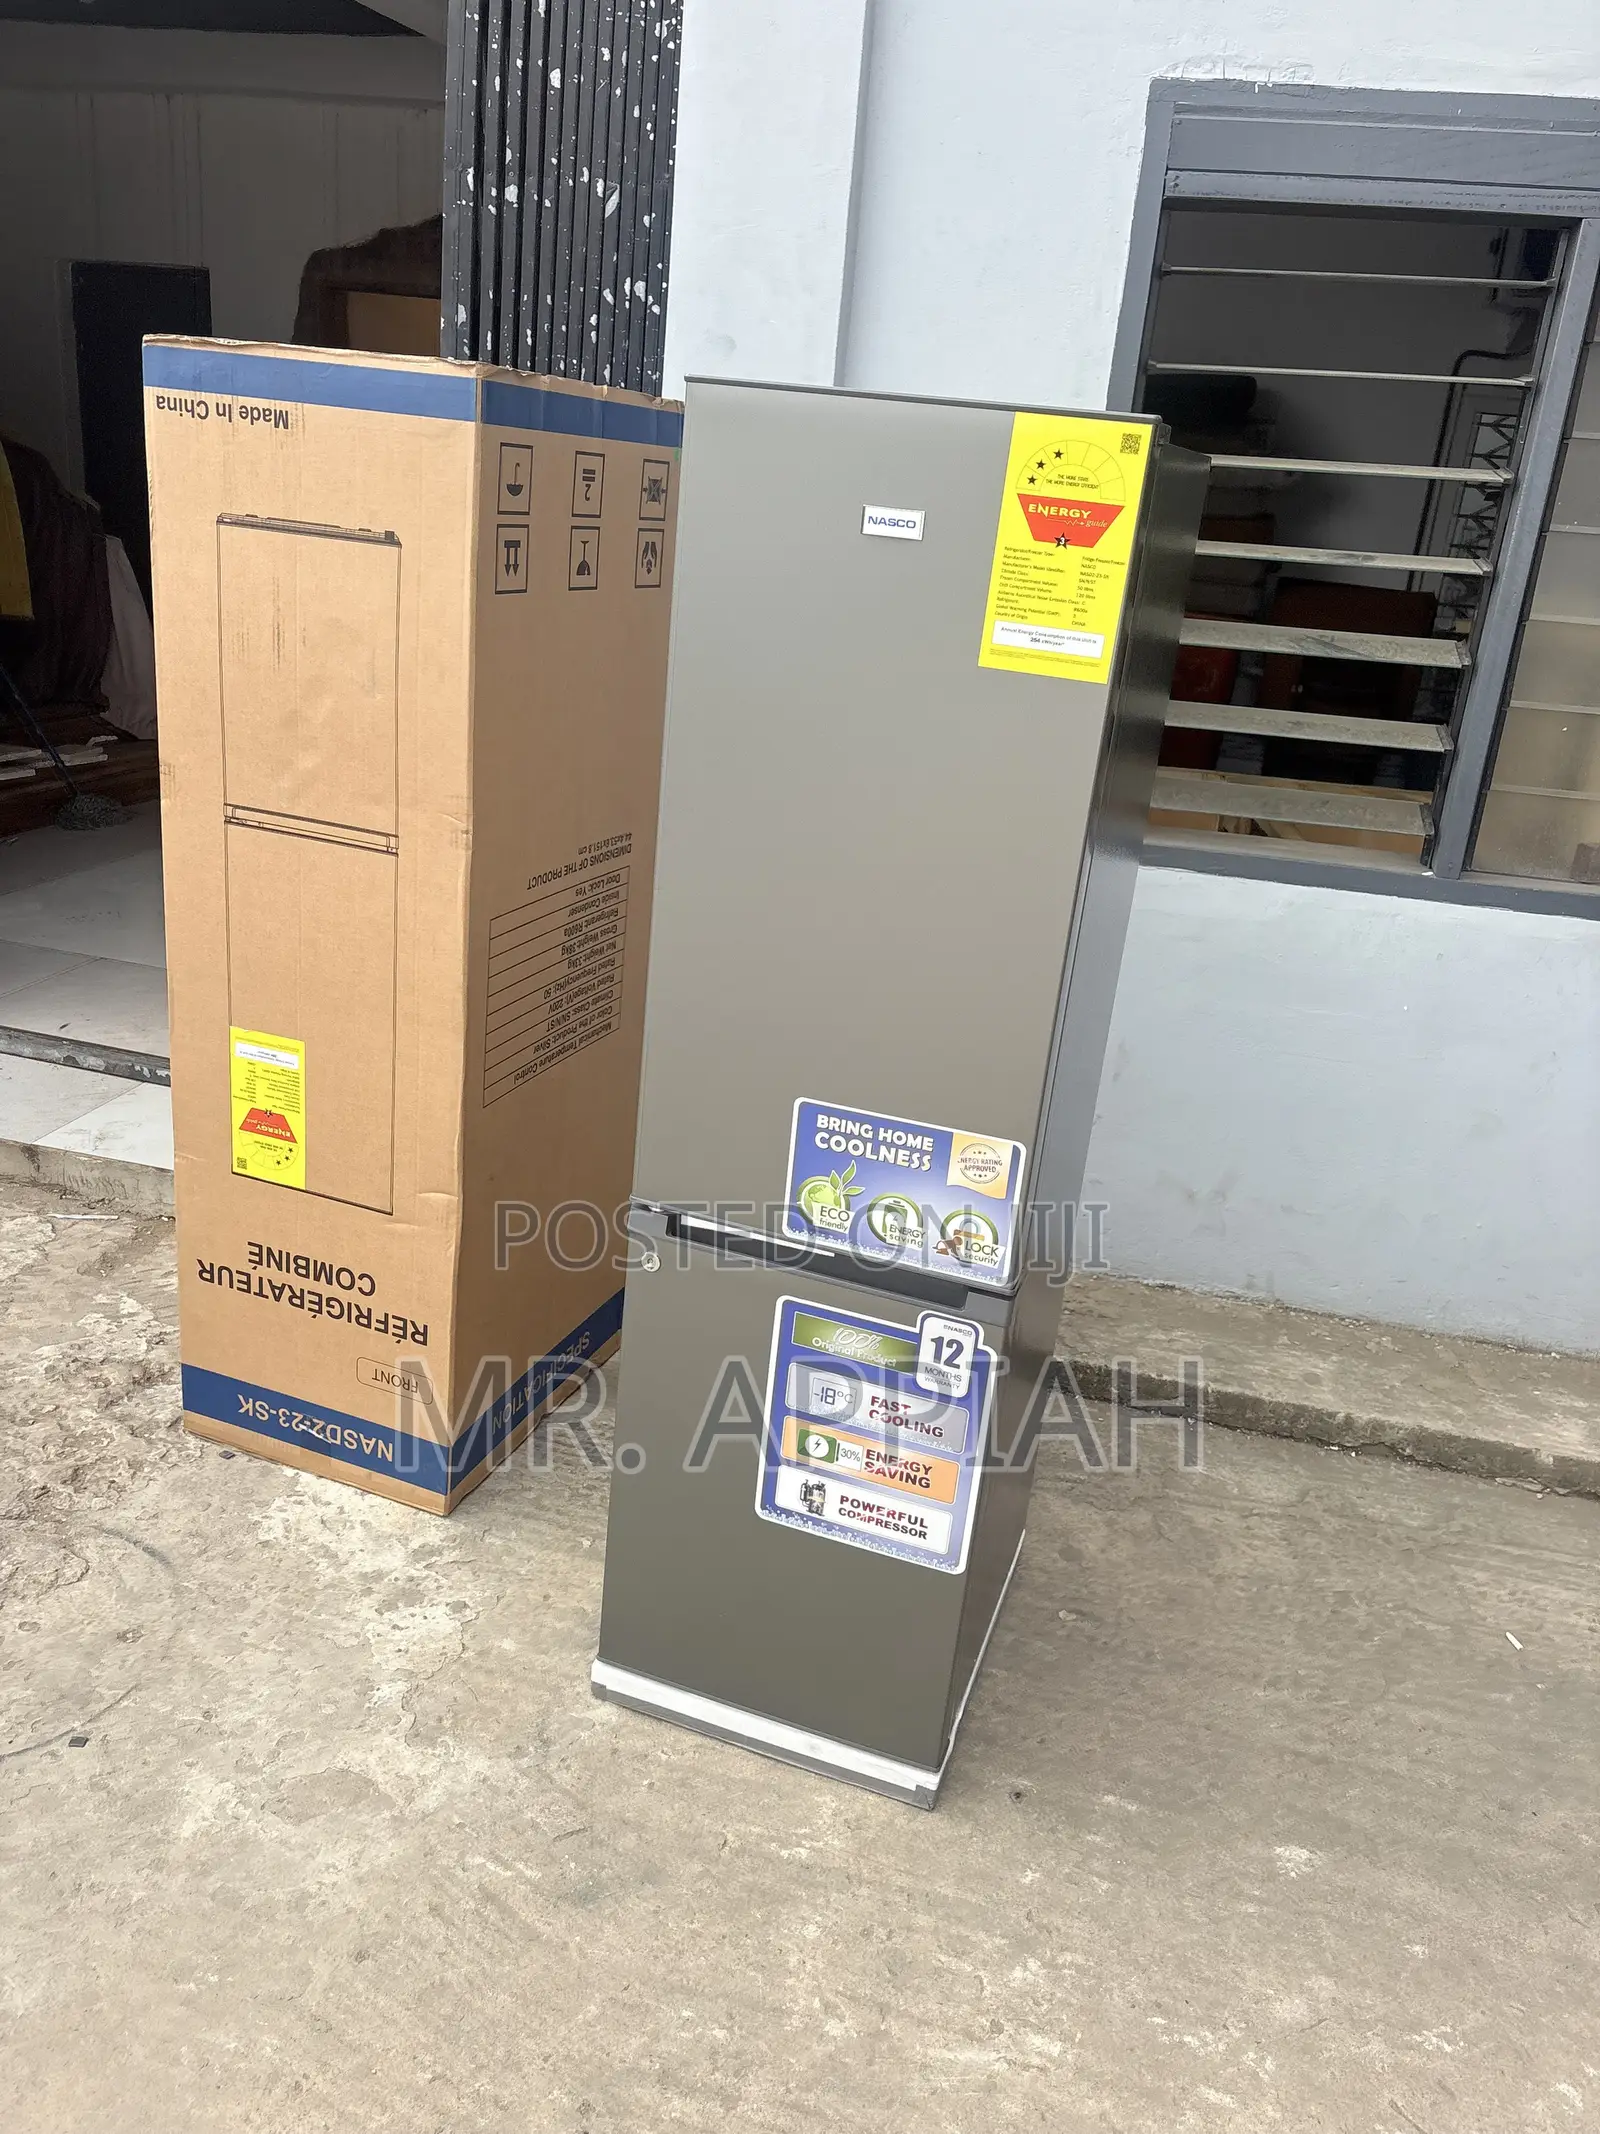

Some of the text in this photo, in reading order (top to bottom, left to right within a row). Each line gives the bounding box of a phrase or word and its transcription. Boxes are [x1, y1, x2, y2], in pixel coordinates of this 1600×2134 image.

[155, 395, 290, 430] Made In China
[1028, 503, 1092, 518] ENERGY
[868, 516, 916, 528] NASCO
[527, 843, 632, 890] DIMENSIONS OF THE PRODUCT
[605, 873, 620, 885] Door
[575, 886, 587, 897] Yes
[568, 898, 600, 917] Condenser
[564, 921, 583, 937] R600a
[600, 924, 617, 936] Gross
[606, 941, 616, 951] Net
[598, 957, 616, 971] Rated
[597, 974, 615, 989] Rated
[544, 988, 551, 1000] 50
[548, 999, 563, 1014] 220V
[597, 1005, 612, 1020] Color
[579, 1019, 588, 1029] the
[589, 1015, 595, 1025] of
[514, 1022, 612, 1084] Mechanical Temperature Control
[533, 1039, 551, 1054] Silver
[256, 1124, 291, 1137] ENERGY
[817, 1114, 933, 1152] BRING HOME
[814, 1132, 932, 1171] COOLNESS
[820, 1206, 850, 1222] ECO
[819, 1219, 848, 1231] friendly
[890, 1224, 926, 1239] ENERGY
[890, 1234, 924, 1248] saving
[965, 1240, 999, 1257] LOCK
[964, 1253, 998, 1266] security
[247, 1241, 376, 1297] COMBINÉ
[196, 1259, 428, 1348] RÉFRIGÉRATEUR
[833, 1327, 883, 1350] 100%
[812, 1338, 896, 1366] Original Product
[931, 1336, 964, 1369] 12
[371, 1368, 418, 1394] FRONT
[924, 1366, 962, 1382] MONTHS
[492, 1331, 590, 1434] SPECIFICATION
[924, 1376, 960, 1389] WARRANTY
[871, 1395, 911, 1415] FAST
[869, 1410, 944, 1438] COOLING
[840, 1448, 860, 1462] 30%
[866, 1449, 932, 1475] ENERGY
[864, 1461, 931, 1489] SAVING
[840, 1495, 928, 1528] POWERFUL
[839, 1508, 927, 1540] COMPRESSOR
